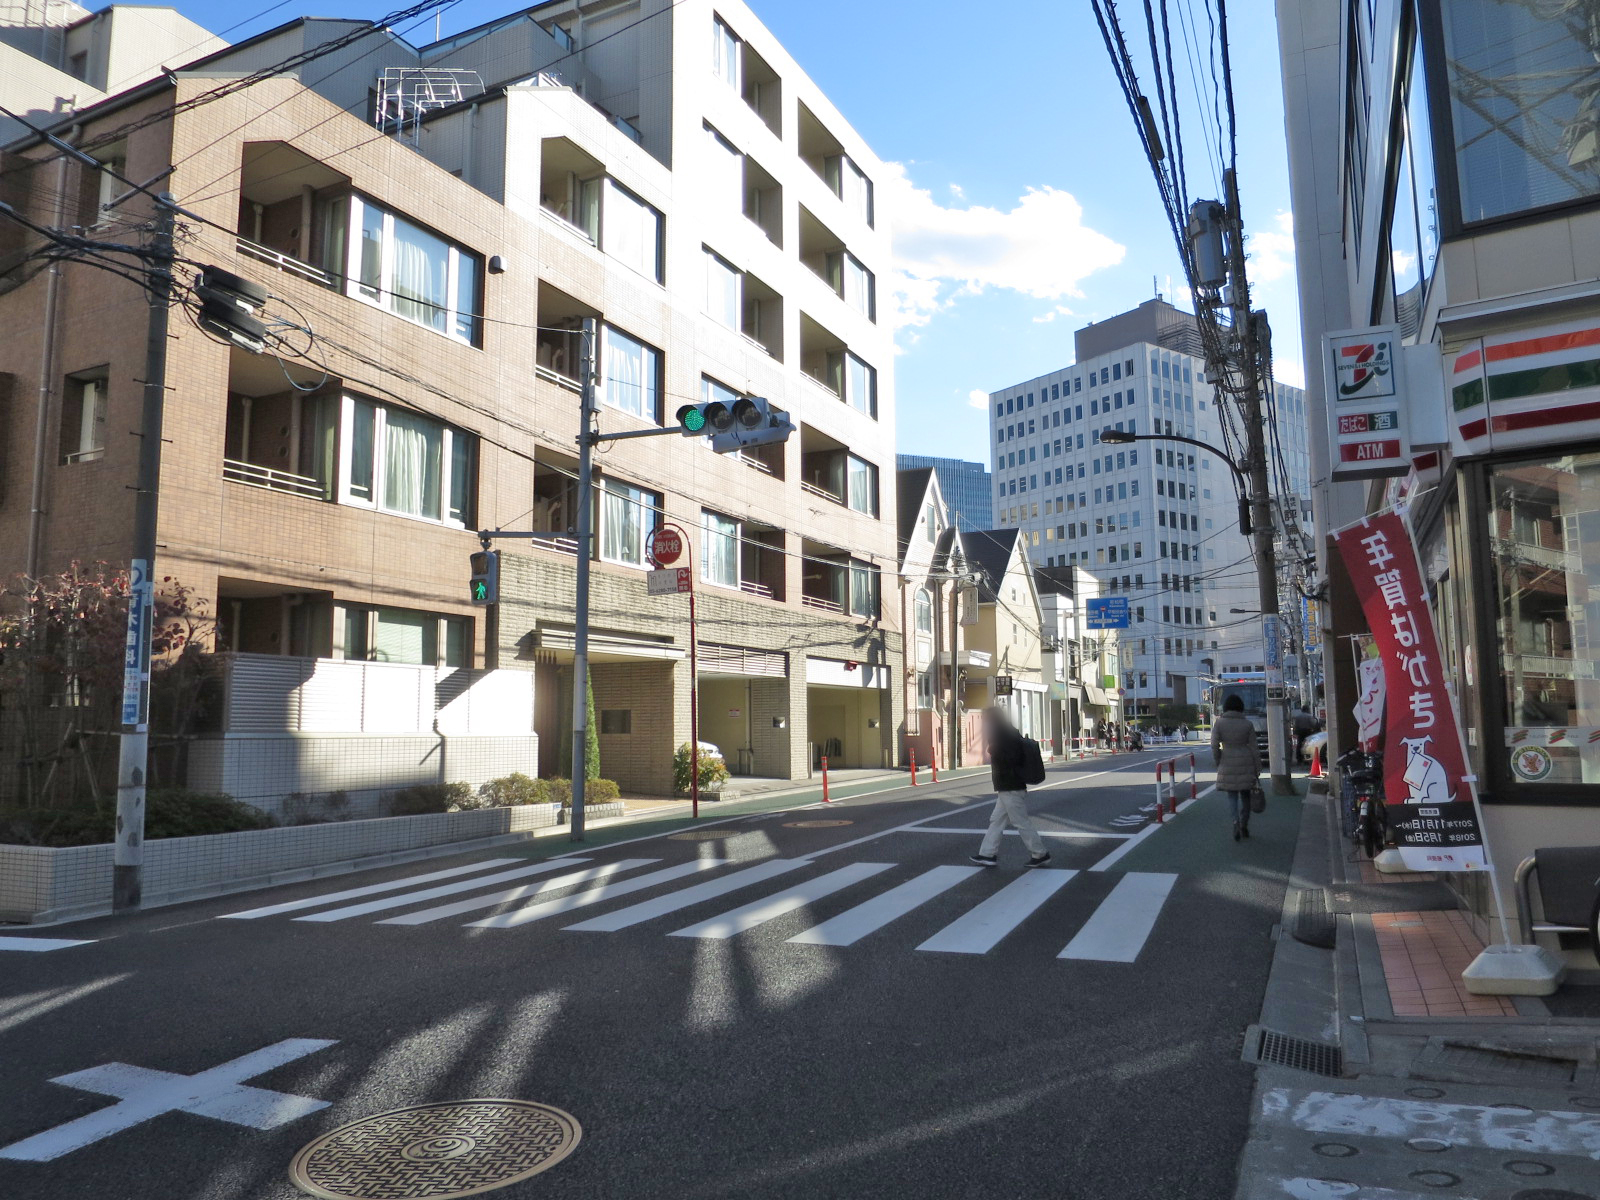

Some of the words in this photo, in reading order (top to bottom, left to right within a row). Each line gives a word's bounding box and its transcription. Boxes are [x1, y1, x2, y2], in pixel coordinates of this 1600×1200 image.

[1361, 360, 1390, 368] HOLDINGS
[1340, 416, 1367, 433] たばこ
[1374, 413, 1391, 430] 酒
[1357, 443, 1383, 460] ATM
[1284, 509, 1299, 549] 評論社
[655, 539, 680, 554] 消火栓
